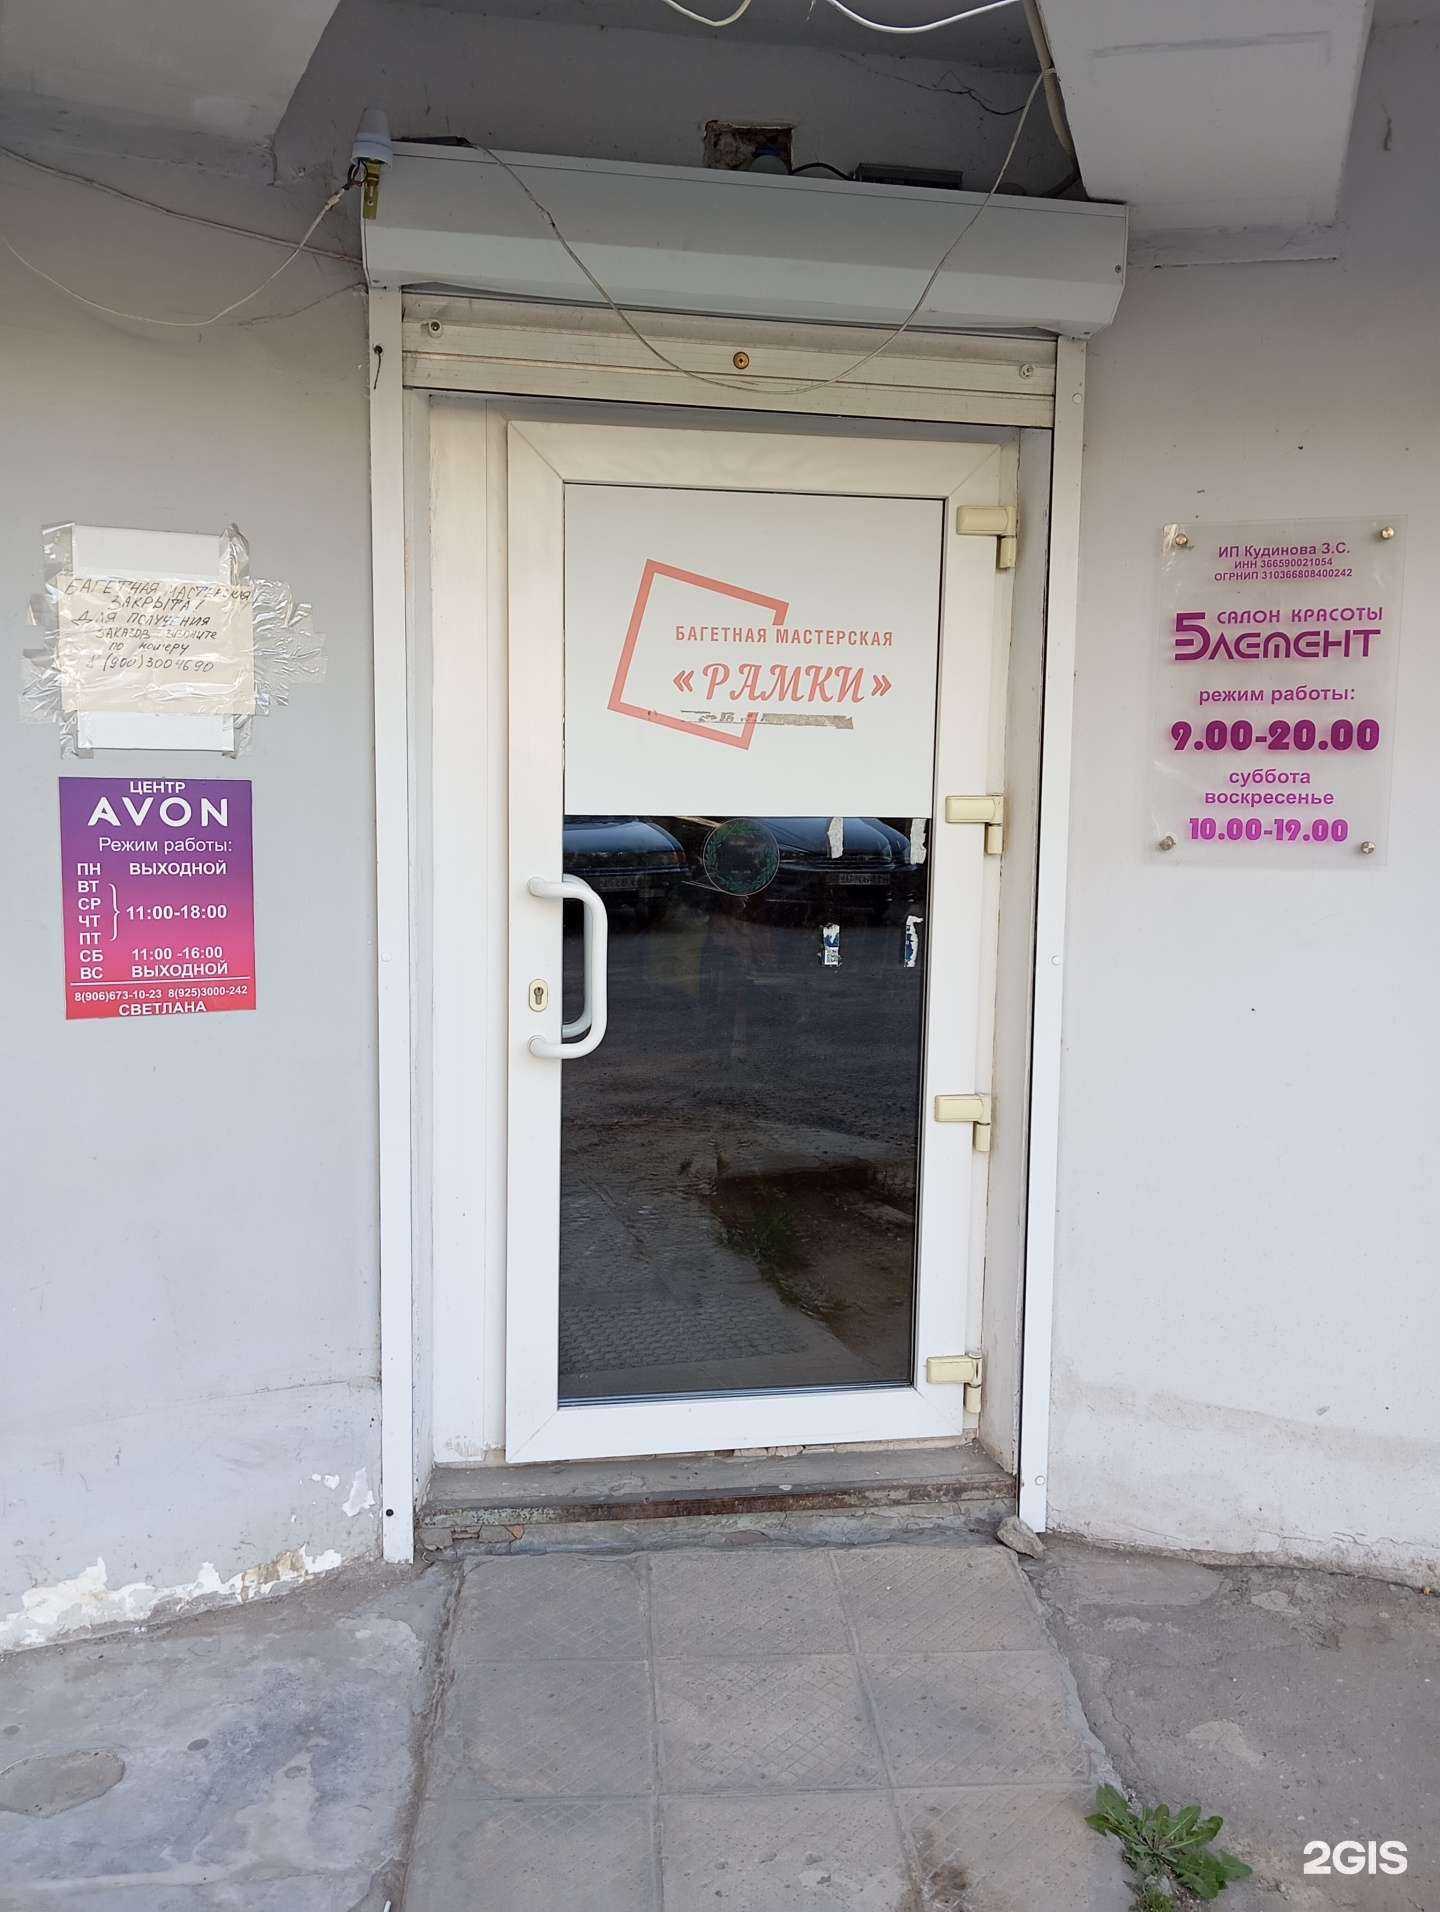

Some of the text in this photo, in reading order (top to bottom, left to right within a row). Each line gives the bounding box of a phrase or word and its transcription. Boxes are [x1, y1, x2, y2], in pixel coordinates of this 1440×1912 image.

[1218, 546, 1239, 558] ИП
[1244, 545, 1317, 559] Кудинова
[1234, 558, 1333, 569] ИНН 366590021054
[1214, 571, 1259, 581] ОГРНИП
[1217, 607, 1383, 624] САЛОН КРАСОТЫ
[675, 625, 893, 647] БАГЕТНАЯ МАСТЕРСКАЯ
[1199, 685, 1355, 705] режим работы:
[1171, 719, 1380, 751] 9.00-20.00
[1229, 768, 1311, 786] суббота
[129, 781, 186, 794] ЦЕНТР
[1205, 791, 1335, 807] воскресенье
[87, 797, 228, 827] AVON
[1189, 817, 1349, 842] 10.00-19.00
[99, 837, 232, 854] Режим работы:
[77, 860, 227, 876] ПН ВЫХОДНОЙ
[78, 880, 99, 893] ВТ
[78, 897, 101, 910] СР
[126, 904, 227, 920] 11:00-18:00
[79, 915, 100, 928] ЧТ
[79, 932, 101, 945] ПТ
[79, 949, 103, 962] СБ
[80, 960, 228, 979] ВС ВЫХОДНОЙ
[74, 985, 248, 1003] 8(906)673-10-23 8(925)3000-242
[118, 1000, 207, 1016] СВЕТЛАНА
